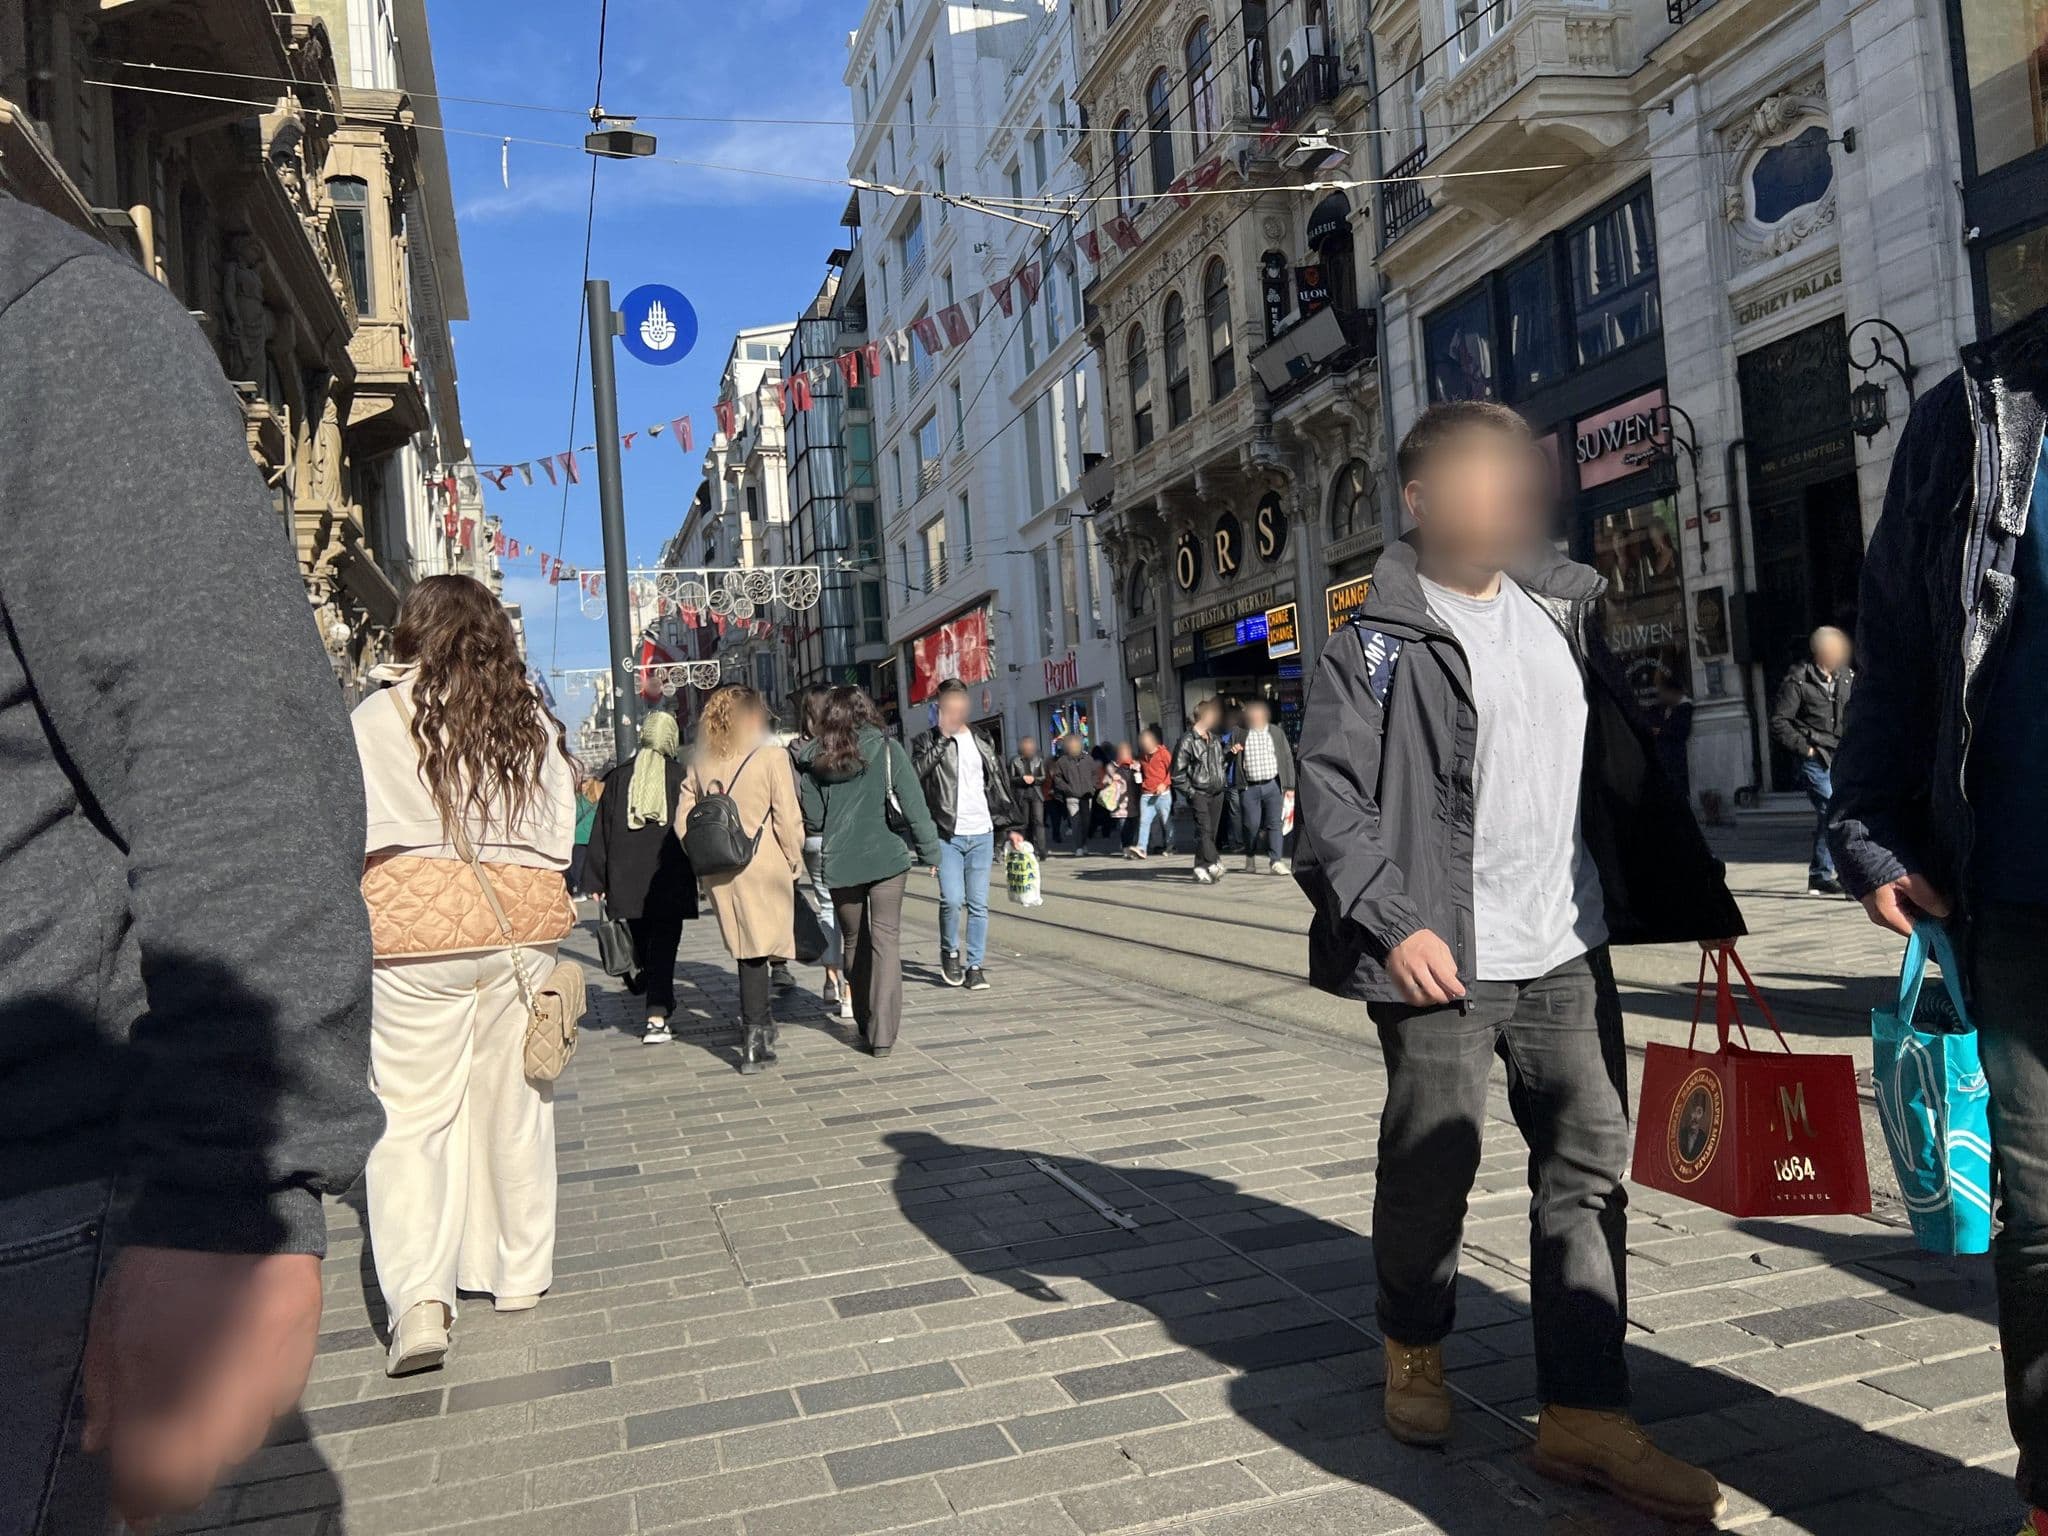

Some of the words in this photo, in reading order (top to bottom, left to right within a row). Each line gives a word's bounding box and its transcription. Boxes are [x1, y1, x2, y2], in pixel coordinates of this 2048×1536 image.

[1739, 291, 1788, 326] GÜNEY
[1793, 268, 1842, 303] PALAS
[1576, 409, 1655, 464] SUWEN
[1177, 506, 1275, 589] ÖRS
[1044, 651, 1078, 694] Penti
[1773, 1156, 1816, 1181] 1864
